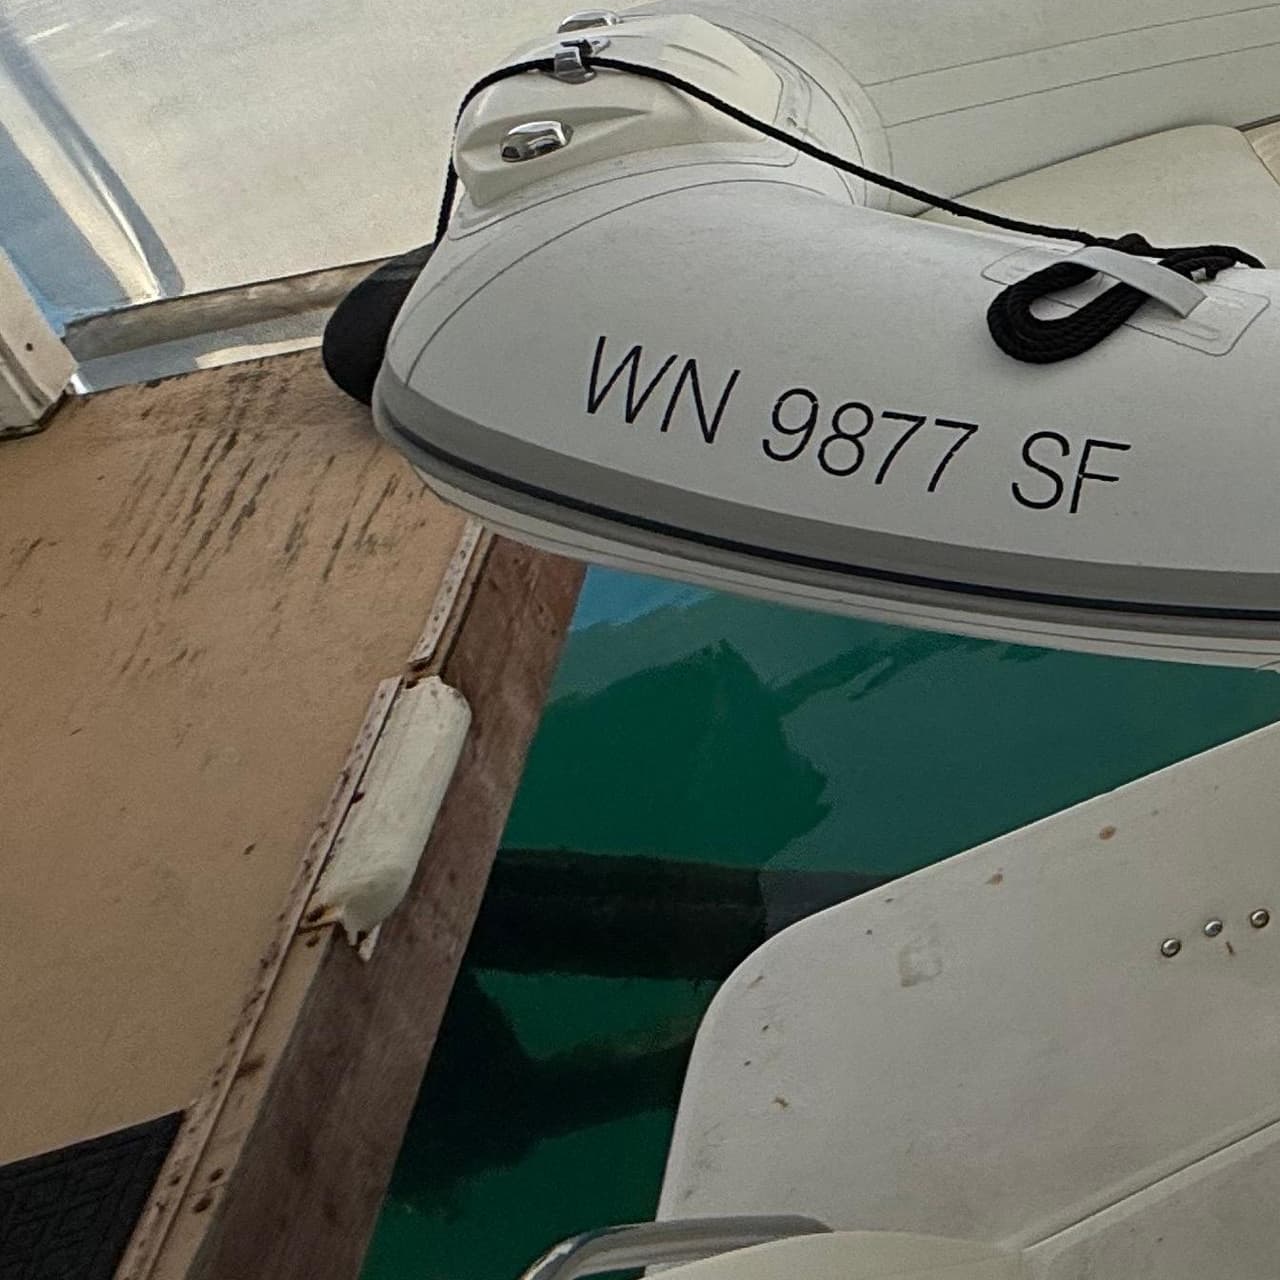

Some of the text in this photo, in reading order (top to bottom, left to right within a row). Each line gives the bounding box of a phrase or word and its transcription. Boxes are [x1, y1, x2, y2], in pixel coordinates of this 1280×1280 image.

[586, 335, 1132, 514] WN 9877 SF
